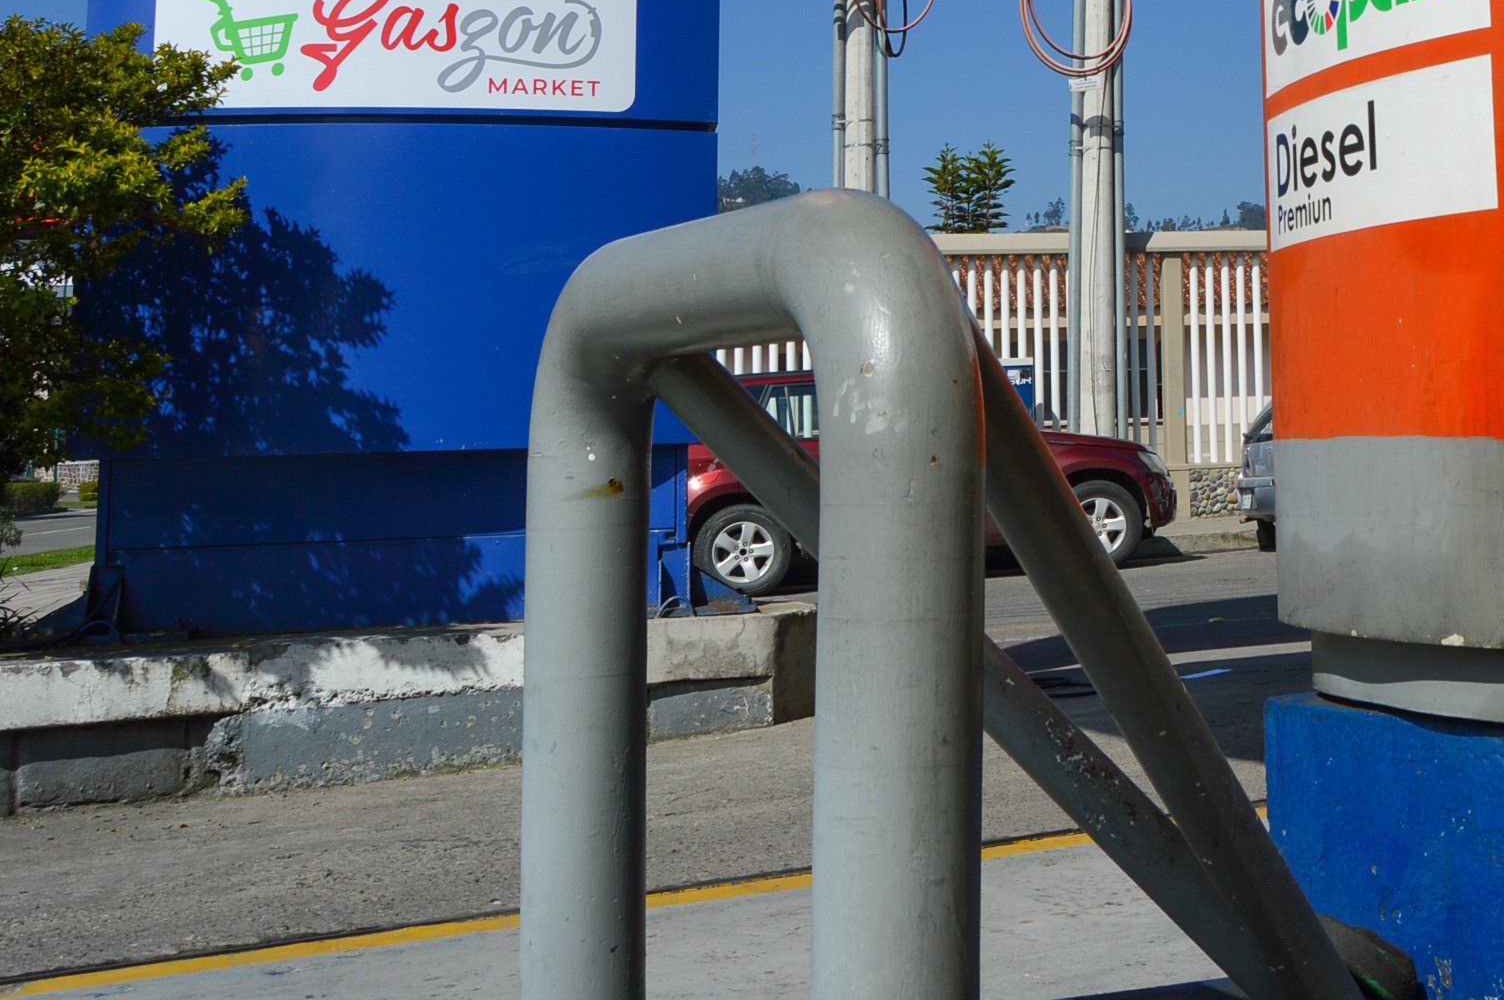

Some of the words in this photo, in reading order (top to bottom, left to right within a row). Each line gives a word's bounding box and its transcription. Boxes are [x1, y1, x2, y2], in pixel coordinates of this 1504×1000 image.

[488, 77, 601, 97] MARKET
[1276, 100, 1378, 198] Diesel
[1278, 193, 1333, 237] Premiun
